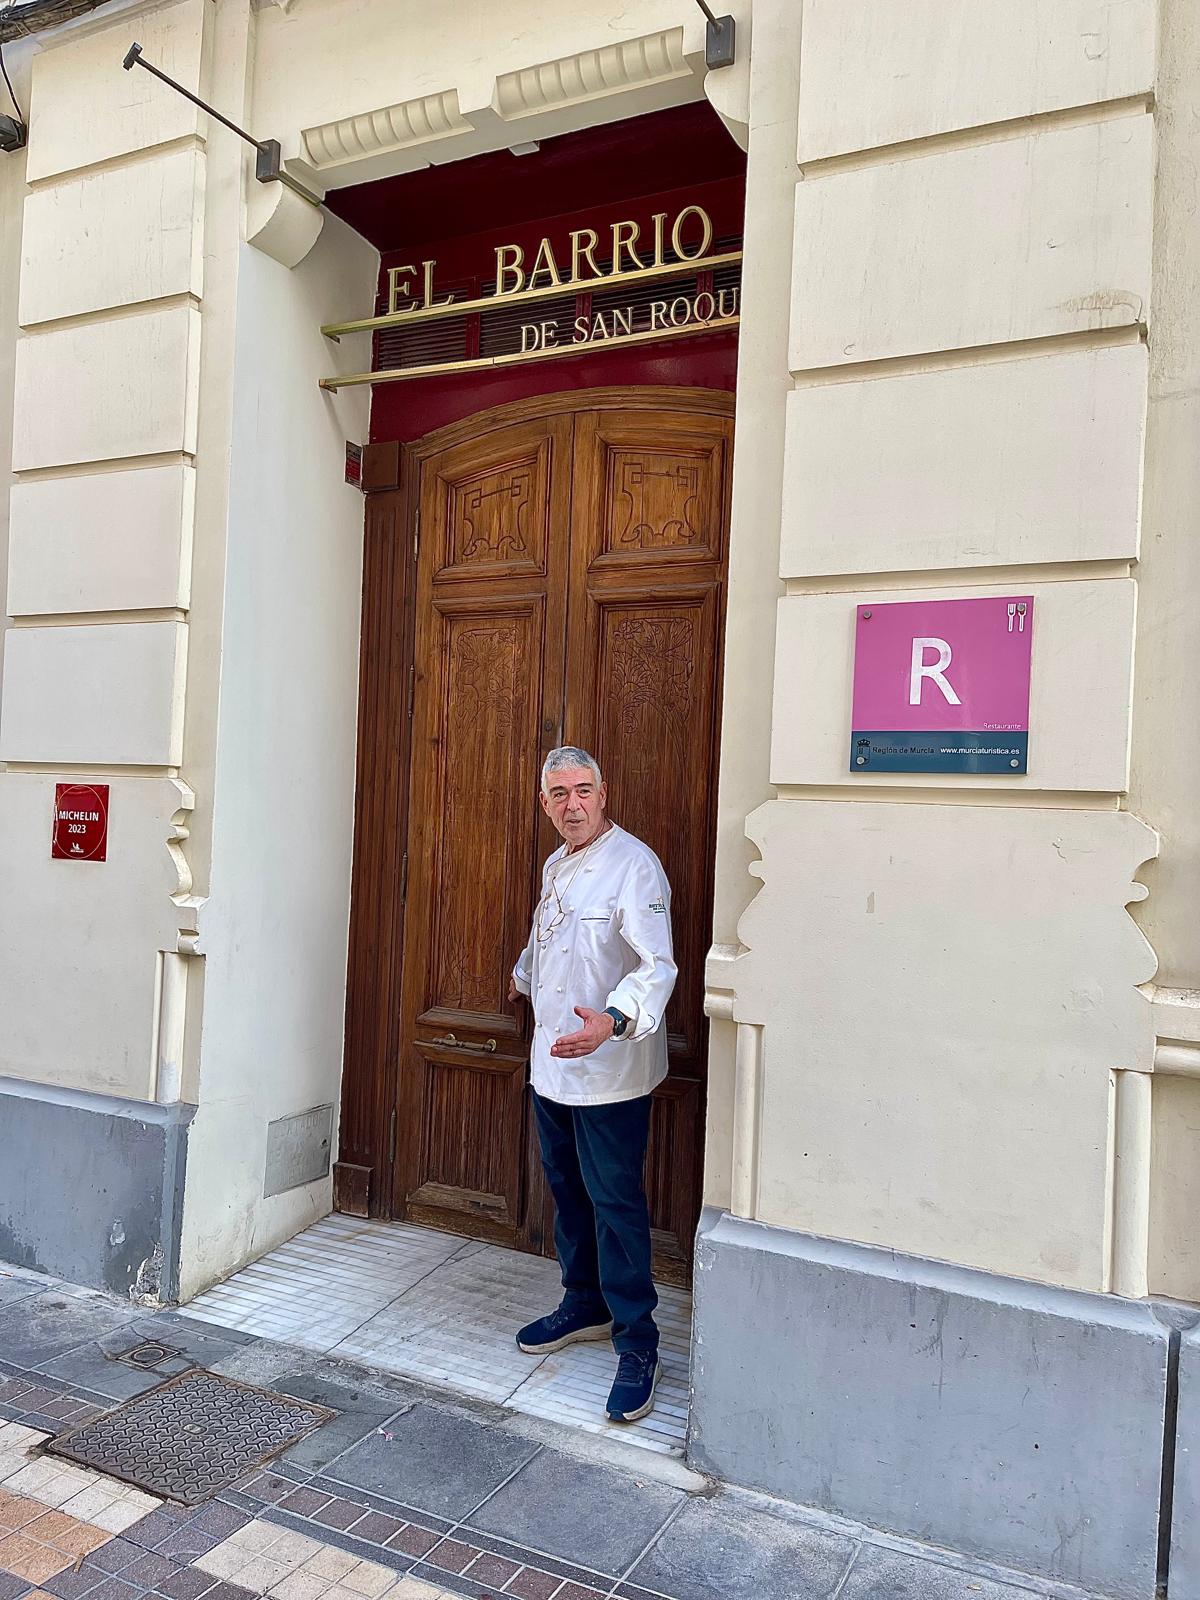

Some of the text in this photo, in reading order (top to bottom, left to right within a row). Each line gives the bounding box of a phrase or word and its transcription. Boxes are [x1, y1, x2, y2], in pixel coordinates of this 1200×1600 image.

[386, 205, 713, 316] EL BARRIO
[520, 321, 559, 354] DE
[572, 307, 634, 344] SAN
[909, 637, 962, 705] R
[983, 722, 1022, 730] Restaurante
[899, 746, 910, 754] de
[910, 746, 935, 754] Murcia
[940, 746, 1020, 755] www.murciaturistica.es
[58, 810, 99, 821] MICHELIN
[68, 824, 87, 834] 2023
